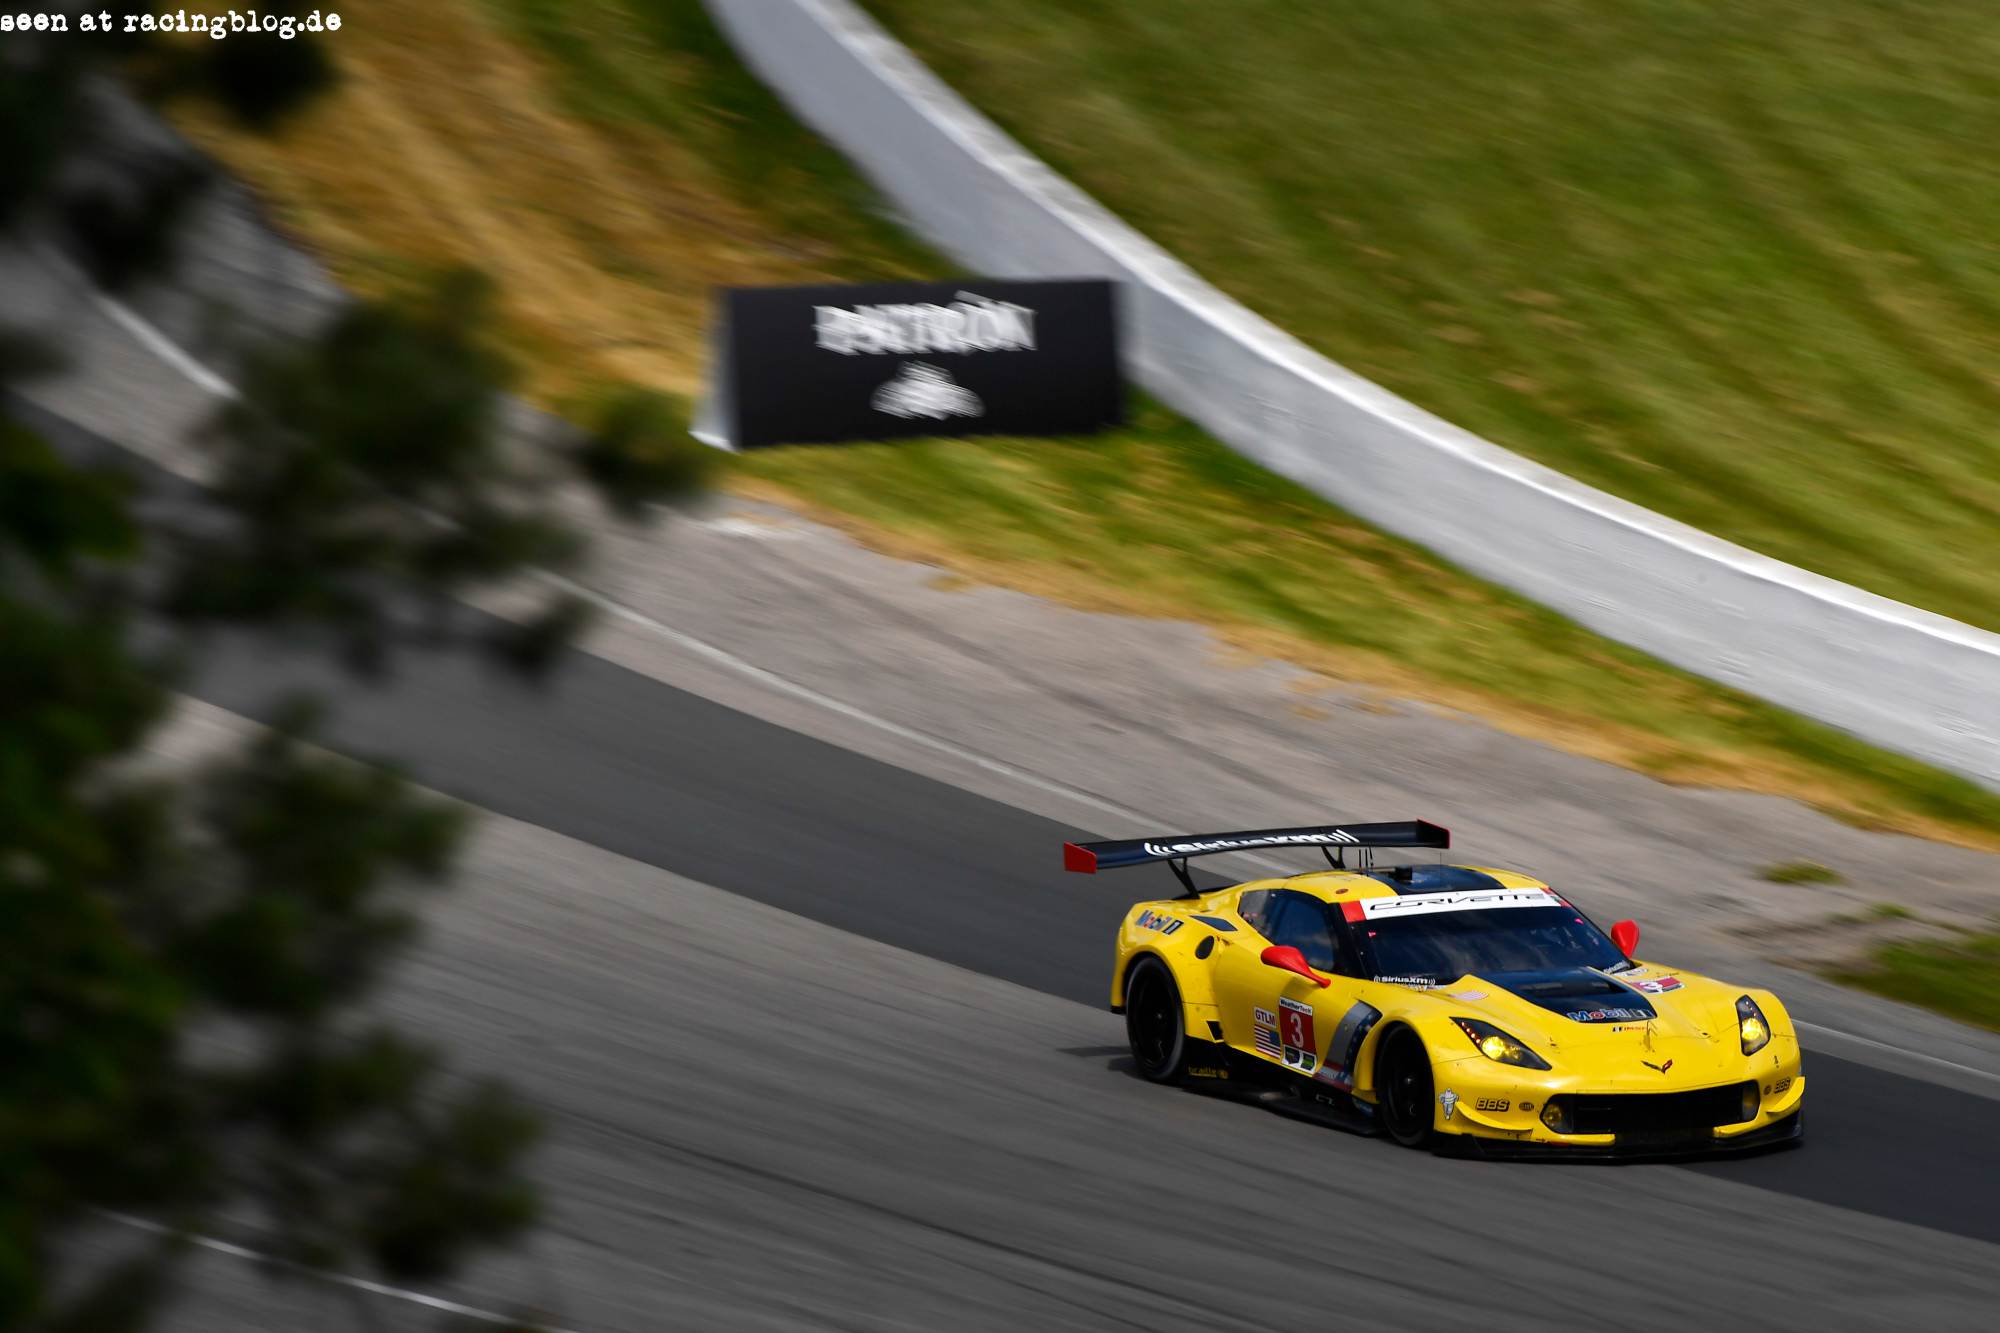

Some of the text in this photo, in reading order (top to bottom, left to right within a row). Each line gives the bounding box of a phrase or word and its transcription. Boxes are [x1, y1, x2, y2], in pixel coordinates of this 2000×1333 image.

[1255, 1009, 1276, 1026] GTLM
[1566, 1008, 1631, 1021] Mobil
[1290, 1012, 1304, 1048] 3
[1476, 1097, 1510, 1112] BBS
